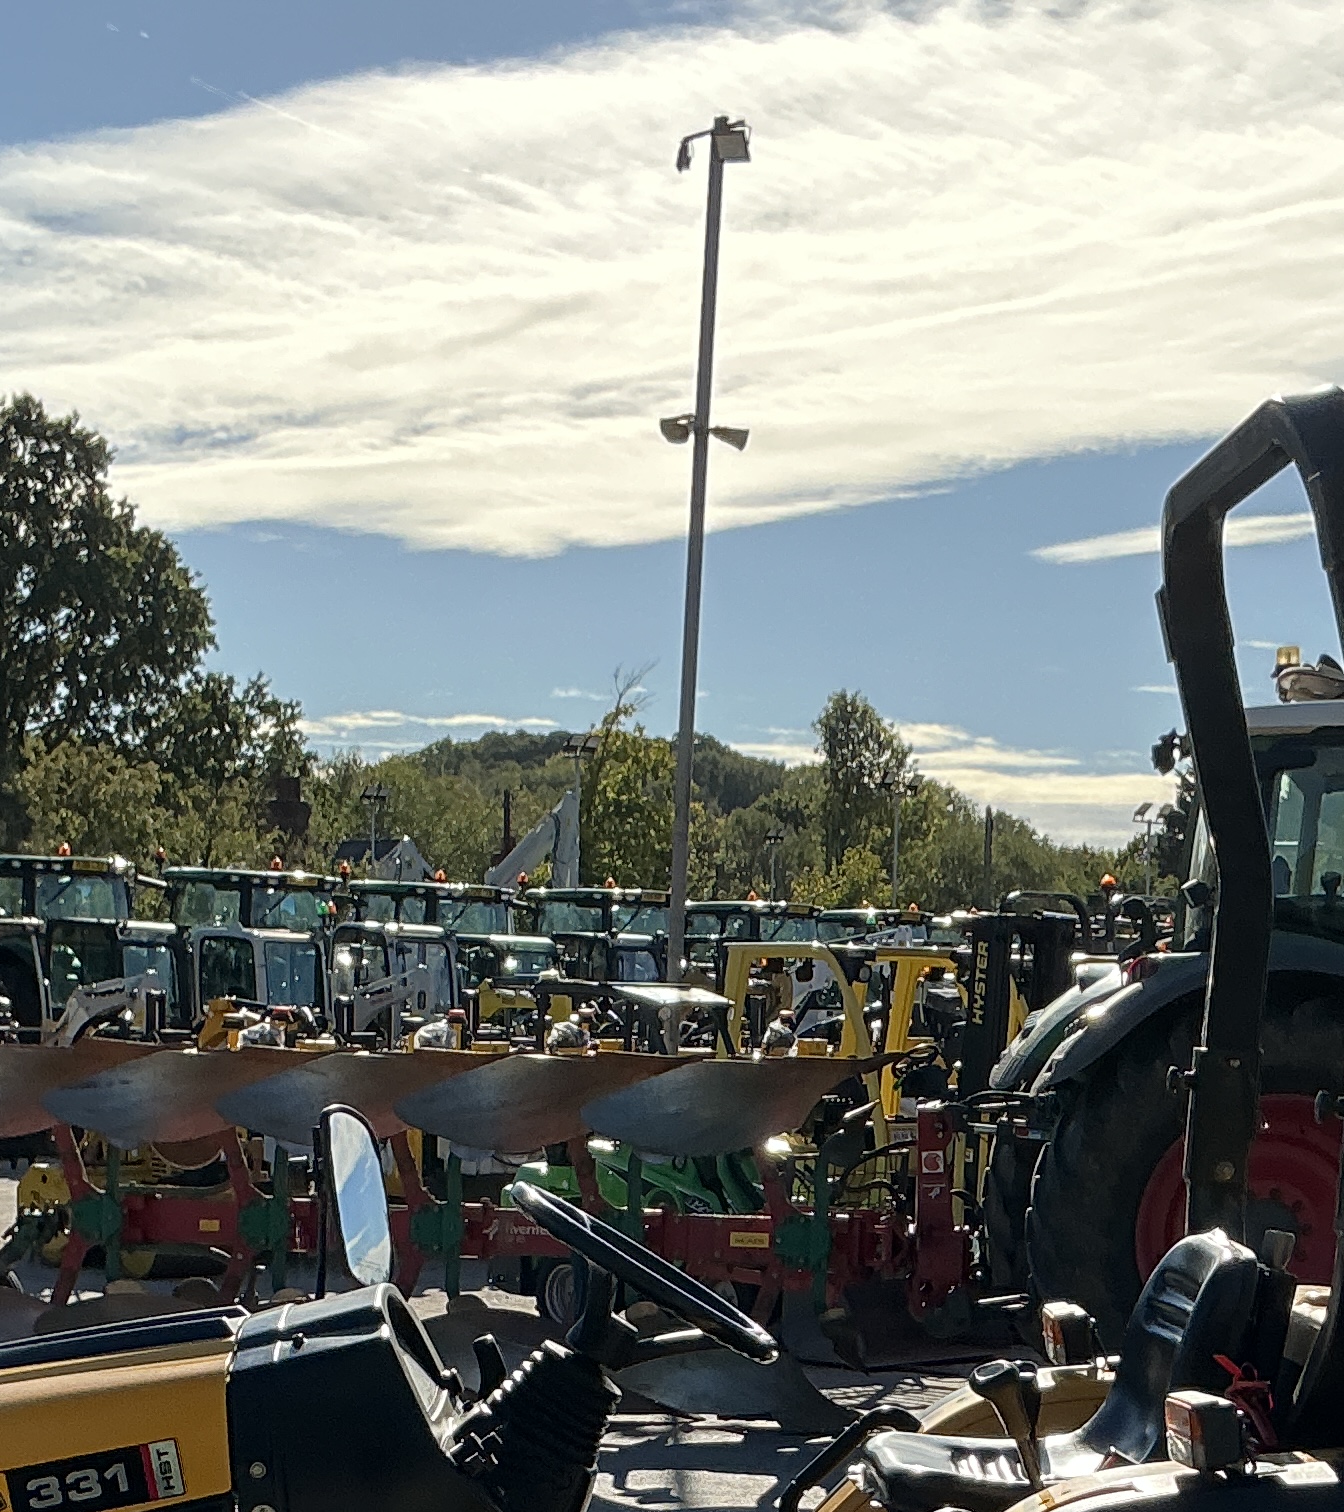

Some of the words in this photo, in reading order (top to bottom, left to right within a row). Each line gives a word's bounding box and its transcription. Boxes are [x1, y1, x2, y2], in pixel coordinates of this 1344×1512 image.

[972, 941, 989, 1025] HYSTER
[26, 1462, 130, 1509] 331
[156, 1447, 177, 1492] HST
